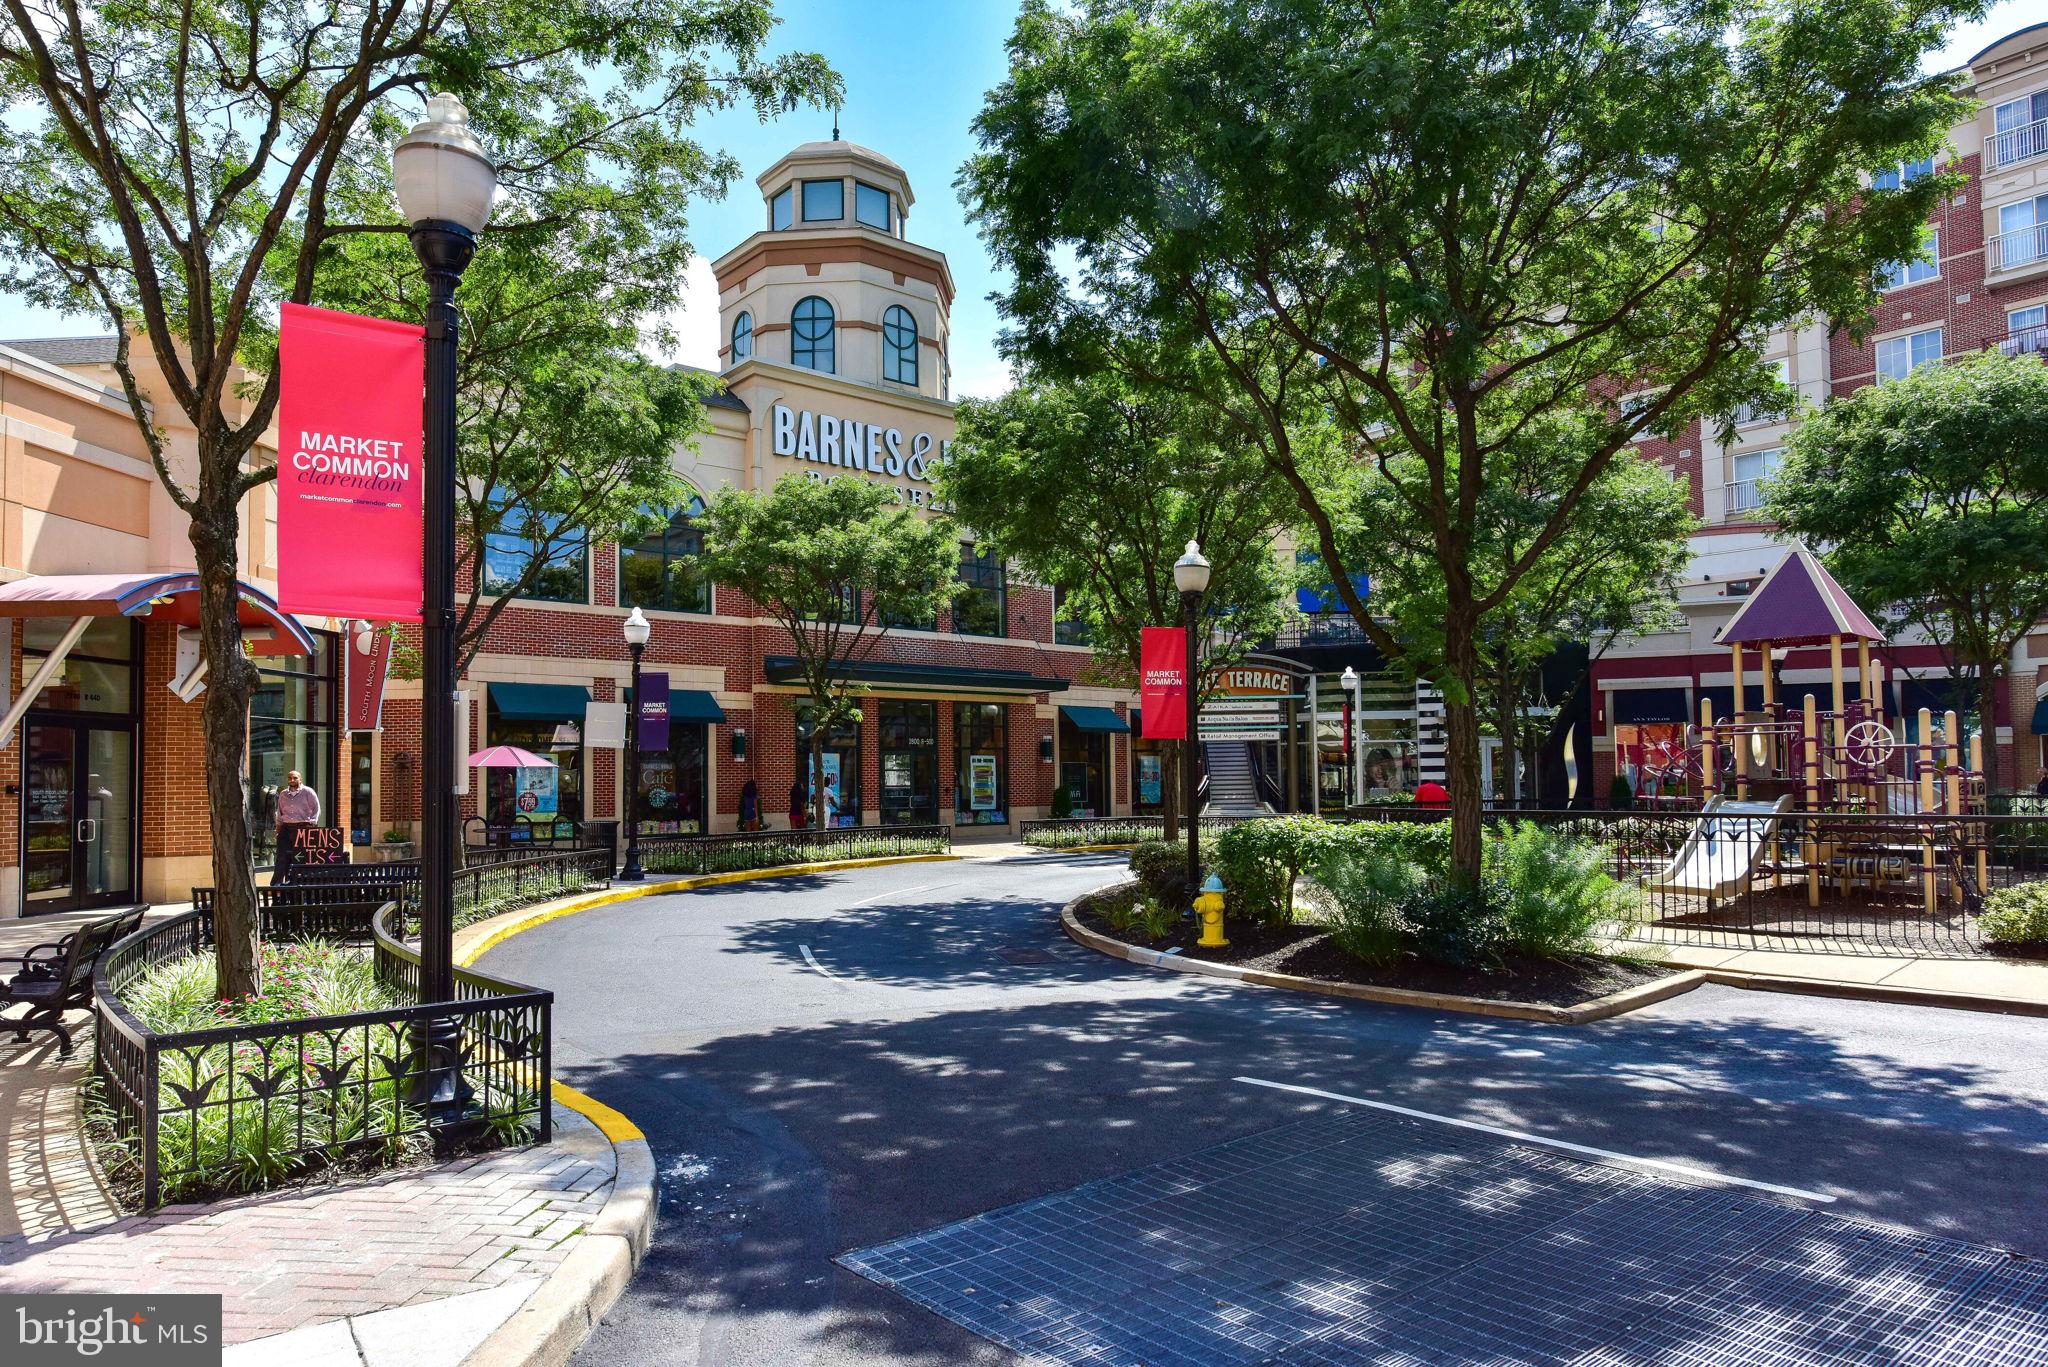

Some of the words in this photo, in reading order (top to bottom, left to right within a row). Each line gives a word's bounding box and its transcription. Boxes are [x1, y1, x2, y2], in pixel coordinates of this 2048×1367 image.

[300, 431, 403, 460] MARKET
[772, 404, 904, 477] BARNES
[292, 451, 409, 480] COMMON
[297, 465, 402, 493] clarendon
[299, 493, 402, 508] marketcommonclarendon.com
[1144, 677, 1182, 686] COMMON
[1146, 670, 1180, 678] MARKET
[1228, 670, 1290, 691] TERRACE
[360, 691, 372, 722] SOUTH
[366, 660, 377, 687] MOON
[294, 828, 341, 849] MENS
[305, 848, 326, 865] IS
